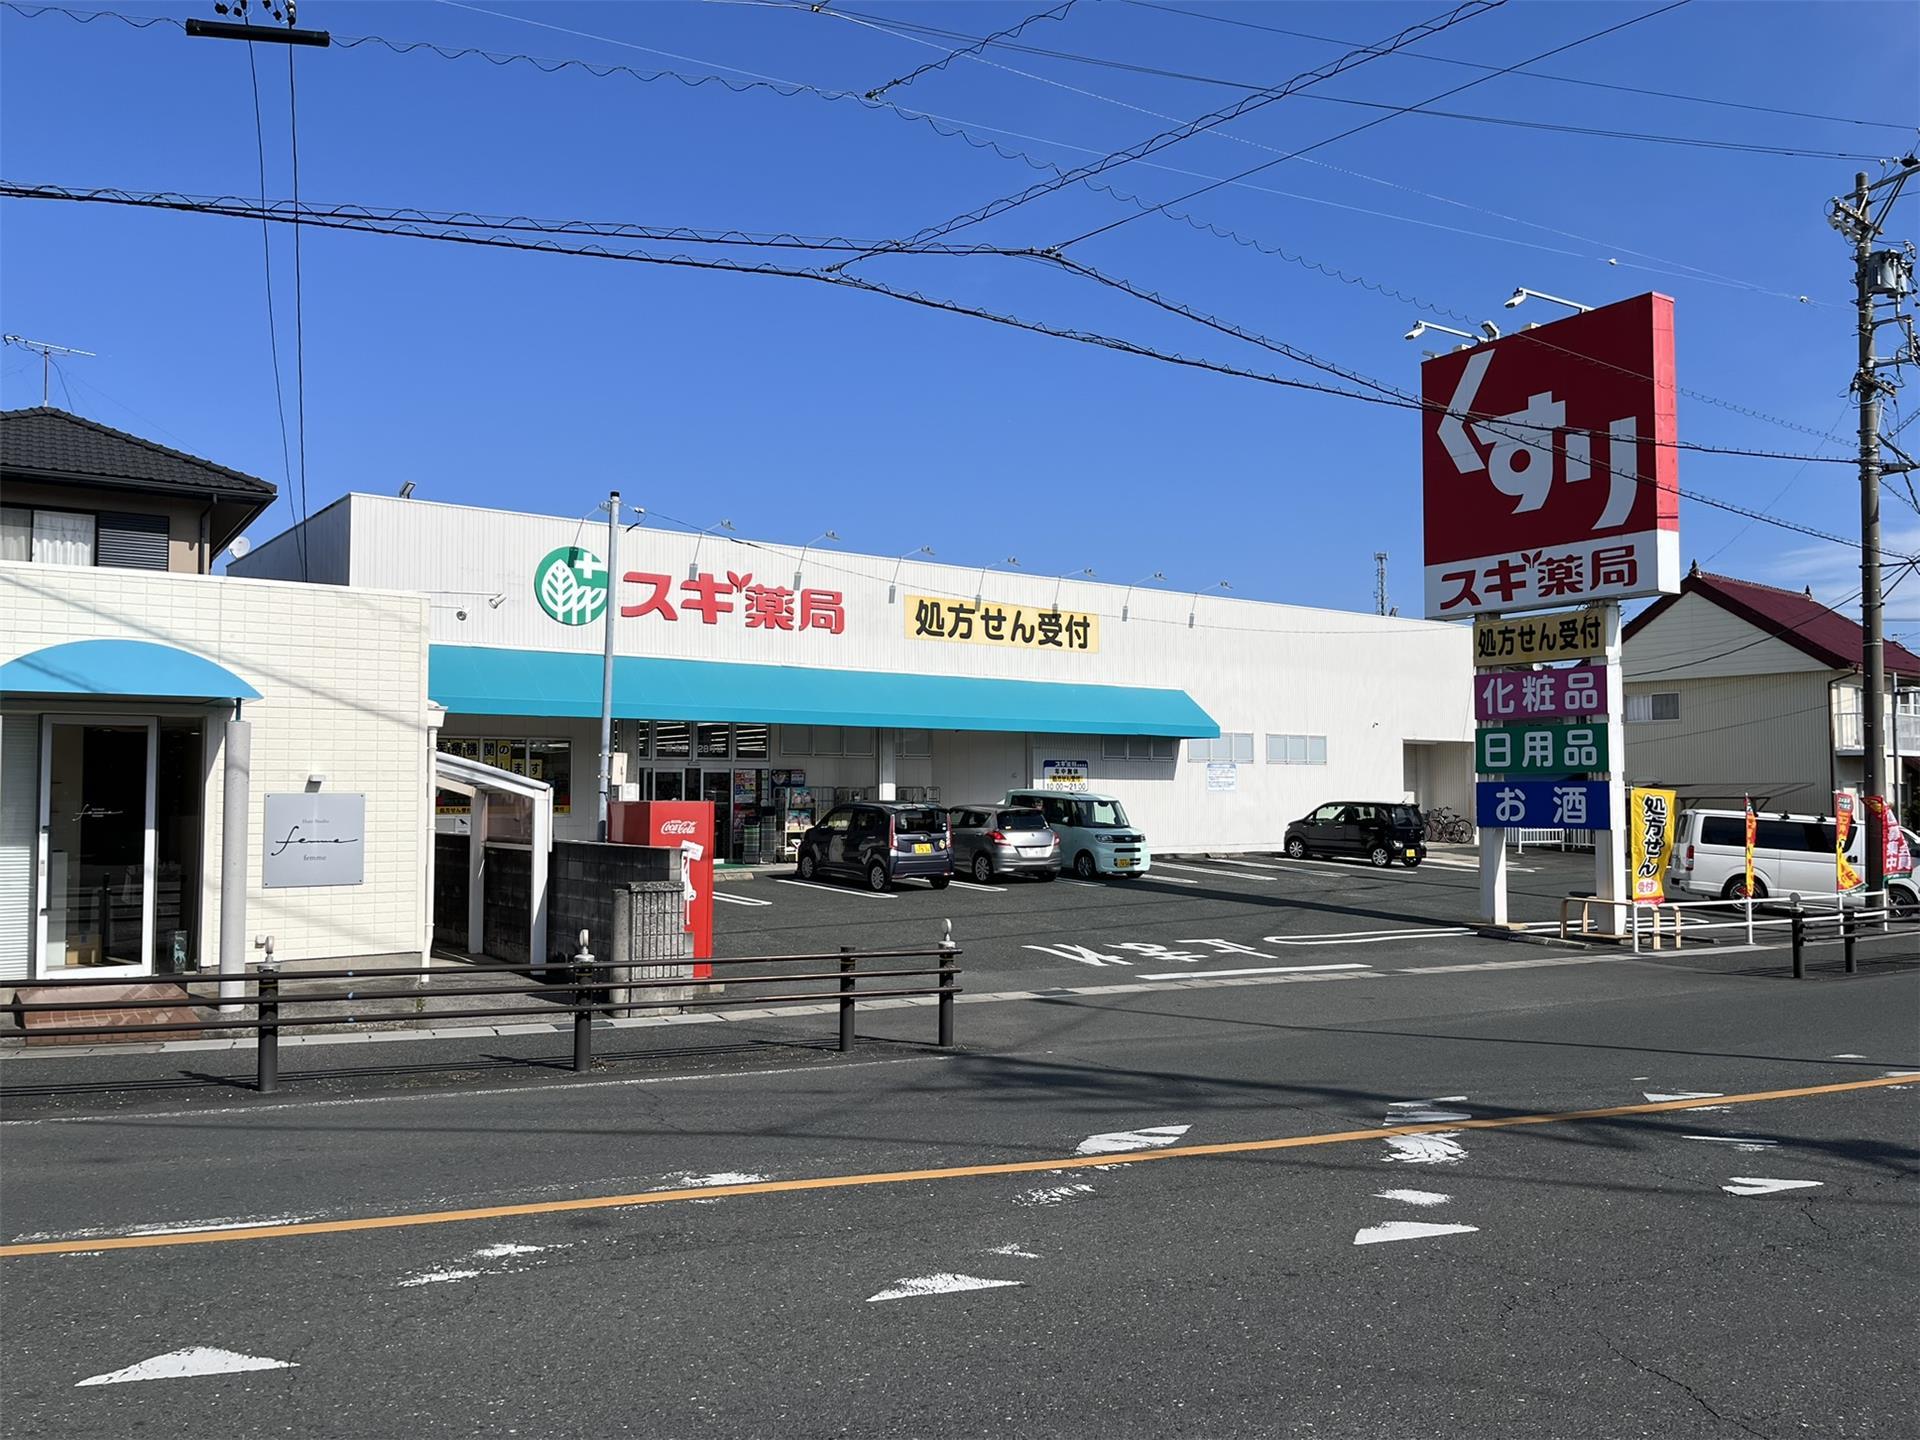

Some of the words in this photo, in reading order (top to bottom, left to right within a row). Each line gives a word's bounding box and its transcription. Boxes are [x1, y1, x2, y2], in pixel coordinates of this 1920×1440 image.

[1437, 348, 1638, 530] くすり
[1440, 545, 1638, 610] スギ薬局
[621, 571, 845, 634] スギ薬局
[915, 600, 1090, 649] 処方せん受付
[1478, 618, 1602, 659] 処方せん受付
[1482, 671, 1599, 715] 化粧品
[1483, 728, 1598, 768] 日用品
[1495, 786, 1587, 824] お酒
[1639, 795, 1667, 877] 処方せん
